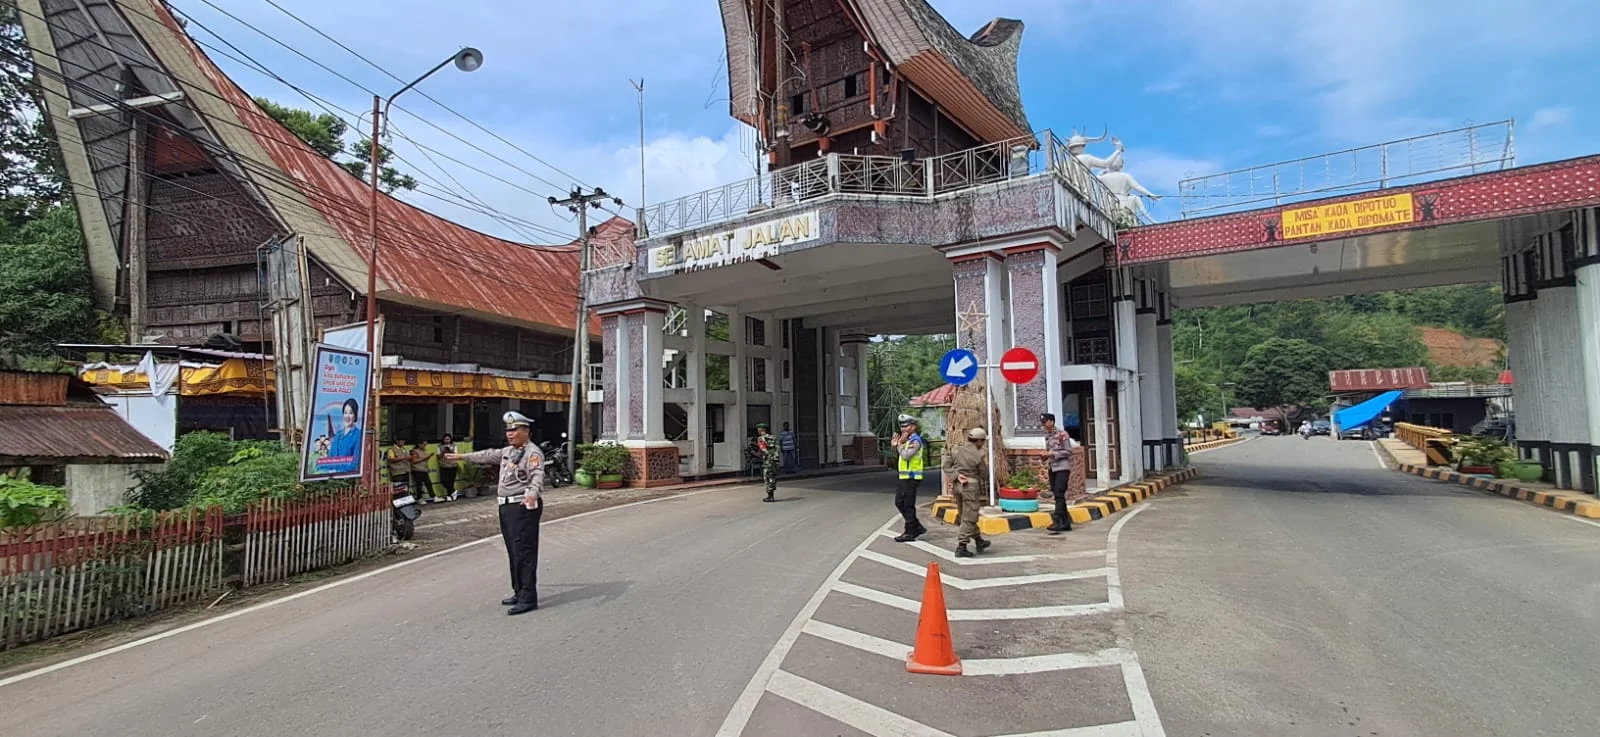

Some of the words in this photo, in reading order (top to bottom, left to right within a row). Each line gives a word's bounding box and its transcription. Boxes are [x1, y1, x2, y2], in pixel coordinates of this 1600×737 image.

[1325, 206, 1349, 218] KADA
[1354, 197, 1396, 214] DIPOTUO
[1284, 222, 1322, 237] PANTAN
[1328, 218, 1352, 230] KADA
[1357, 209, 1411, 227] DIPOMATE
[655, 231, 735, 268] SELAMAT
[744, 215, 810, 250] JALAN
